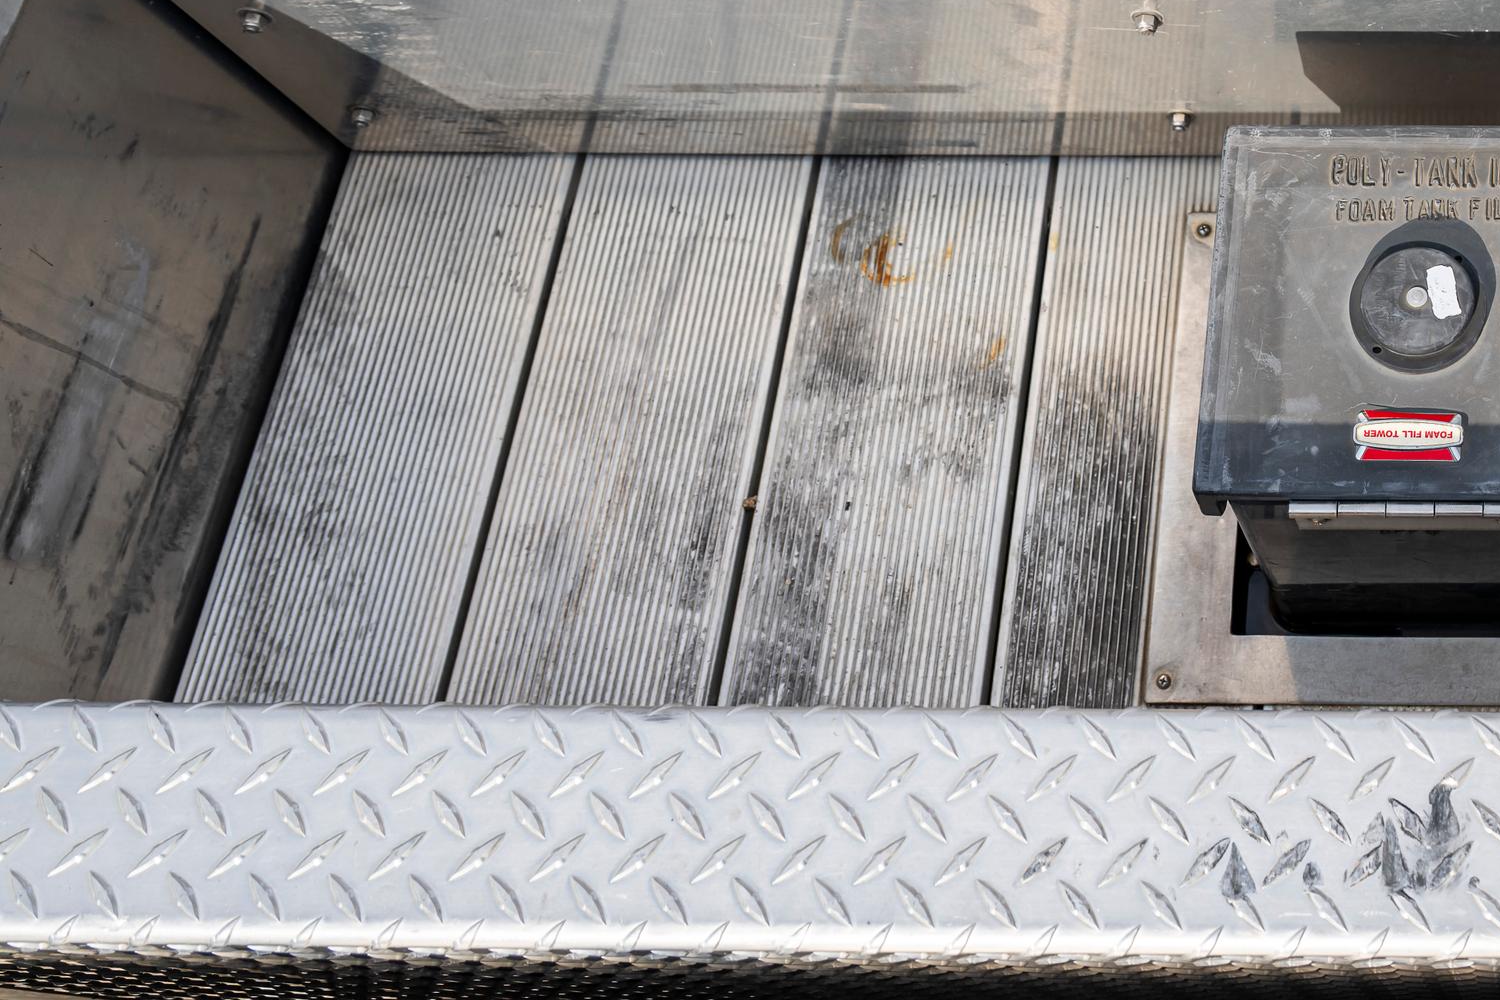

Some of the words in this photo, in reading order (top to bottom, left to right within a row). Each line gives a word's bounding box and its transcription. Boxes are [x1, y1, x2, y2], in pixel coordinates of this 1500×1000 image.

[1331, 154, 1478, 189] POLY-TANK
[1335, 197, 1395, 222] FOAM
[1402, 196, 1459, 221] TANK
[1363, 429, 1399, 438] TOWER
[1402, 430, 1422, 438] FILL
[1424, 430, 1453, 439] FOAM
